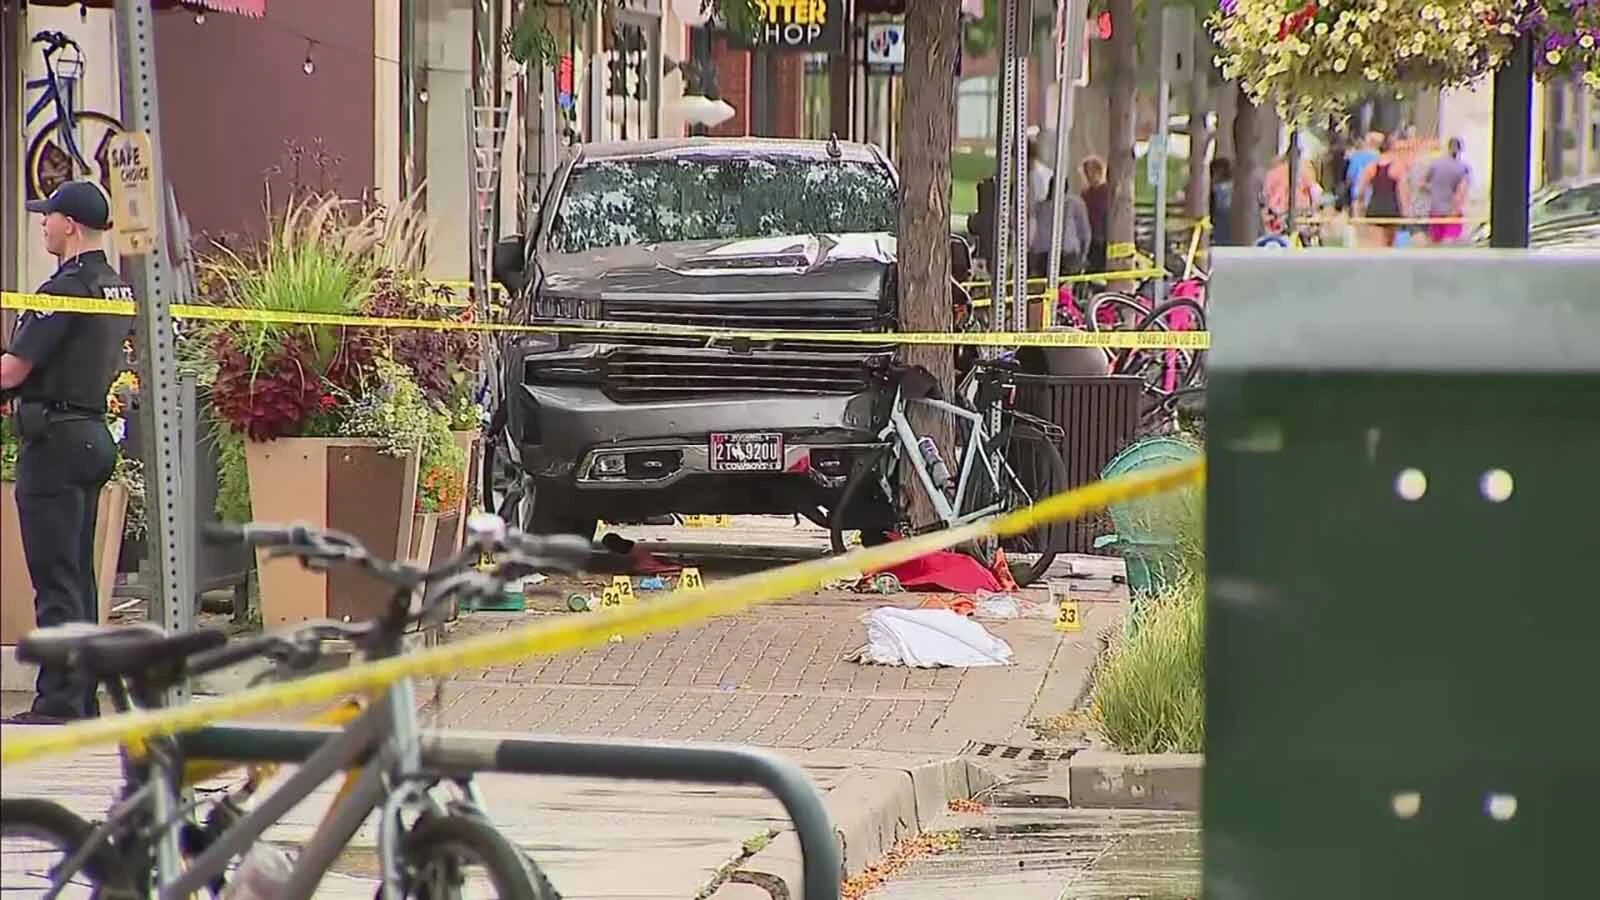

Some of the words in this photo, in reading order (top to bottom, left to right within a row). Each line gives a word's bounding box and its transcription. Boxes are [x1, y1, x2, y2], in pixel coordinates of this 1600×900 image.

[112, 147, 141, 168] SAFE
[685, 574, 700, 588] 31
[604, 592, 620, 607] 34
[1059, 607, 1076, 623] 33
